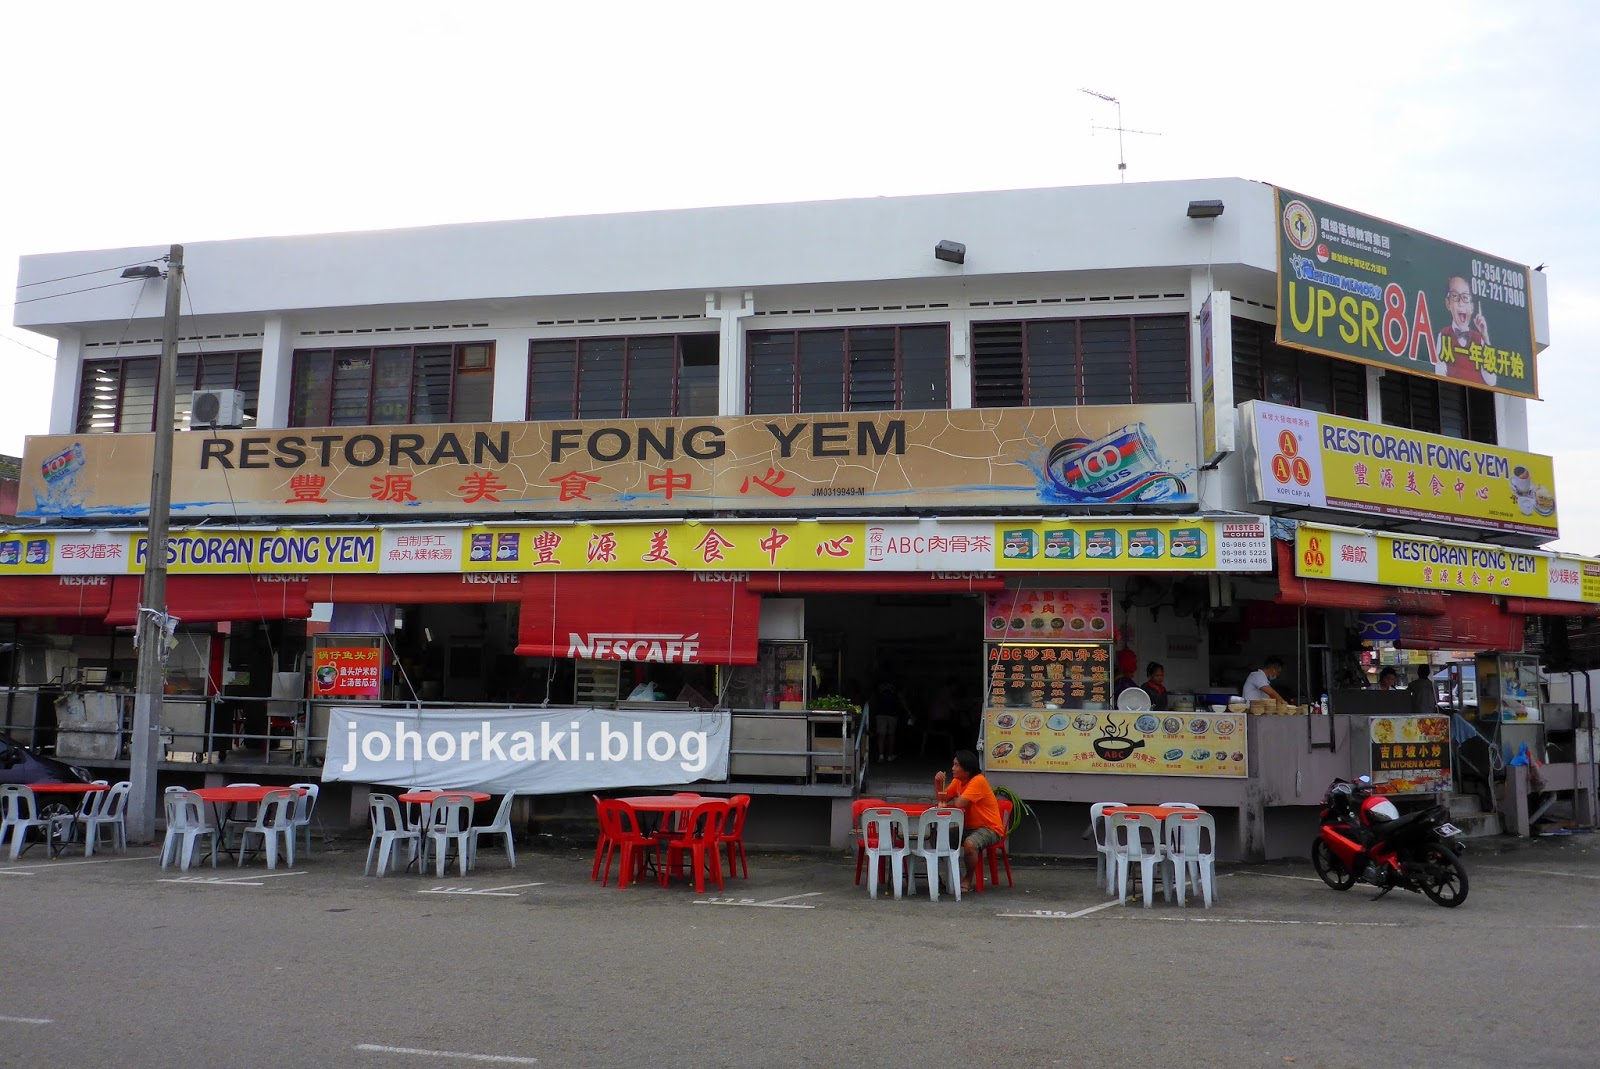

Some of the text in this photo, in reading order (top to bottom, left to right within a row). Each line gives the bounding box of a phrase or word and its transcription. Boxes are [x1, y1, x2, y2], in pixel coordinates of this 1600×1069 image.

[1321, 231, 1391, 258] Super Education Group
[1471, 258, 1524, 290] 07-354 2900
[1341, 275, 1382, 300] MEMORY
[1471, 277, 1525, 308] 012-721 7900
[1288, 281, 1438, 365] UPSR 8A
[1440, 335, 1524, 379] 从一年级开始
[200, 420, 906, 470] RESTORAN FONG YEM
[1322, 424, 1509, 479] RESTORAN FONG YEM
[46, 456, 66, 475] 100
[49, 468, 70, 481] PLUS
[1073, 444, 1122, 483] 100
[285, 467, 796, 504] 豐源美食中心
[811, 487, 866, 497] JM0319949-M
[1087, 468, 1132, 493] PLUS
[1291, 489, 1302, 497] CAP
[1353, 461, 1489, 500] 豐源美食中心
[60, 543, 123, 559] 客家擂茶
[136, 535, 375, 564] RSTORAN FONG YEM
[397, 535, 446, 547] 自制手工
[532, 528, 856, 567] 豐源美食中心
[388, 548, 453, 561] 魚丸粿條湯
[1392, 539, 1536, 574] RESTORAN FONG YEM
[1549, 568, 1579, 585] 炒粿條
[988, 648, 1022, 661] ABC
[1103, 750, 1125, 760] ABC
[1132, 751, 1157, 765] 肉骨茶
[1380, 744, 1442, 759] 吉隆坡小炒
[1390, 760, 1418, 769] KITCHEN
[1425, 759, 1441, 768] CAFE
